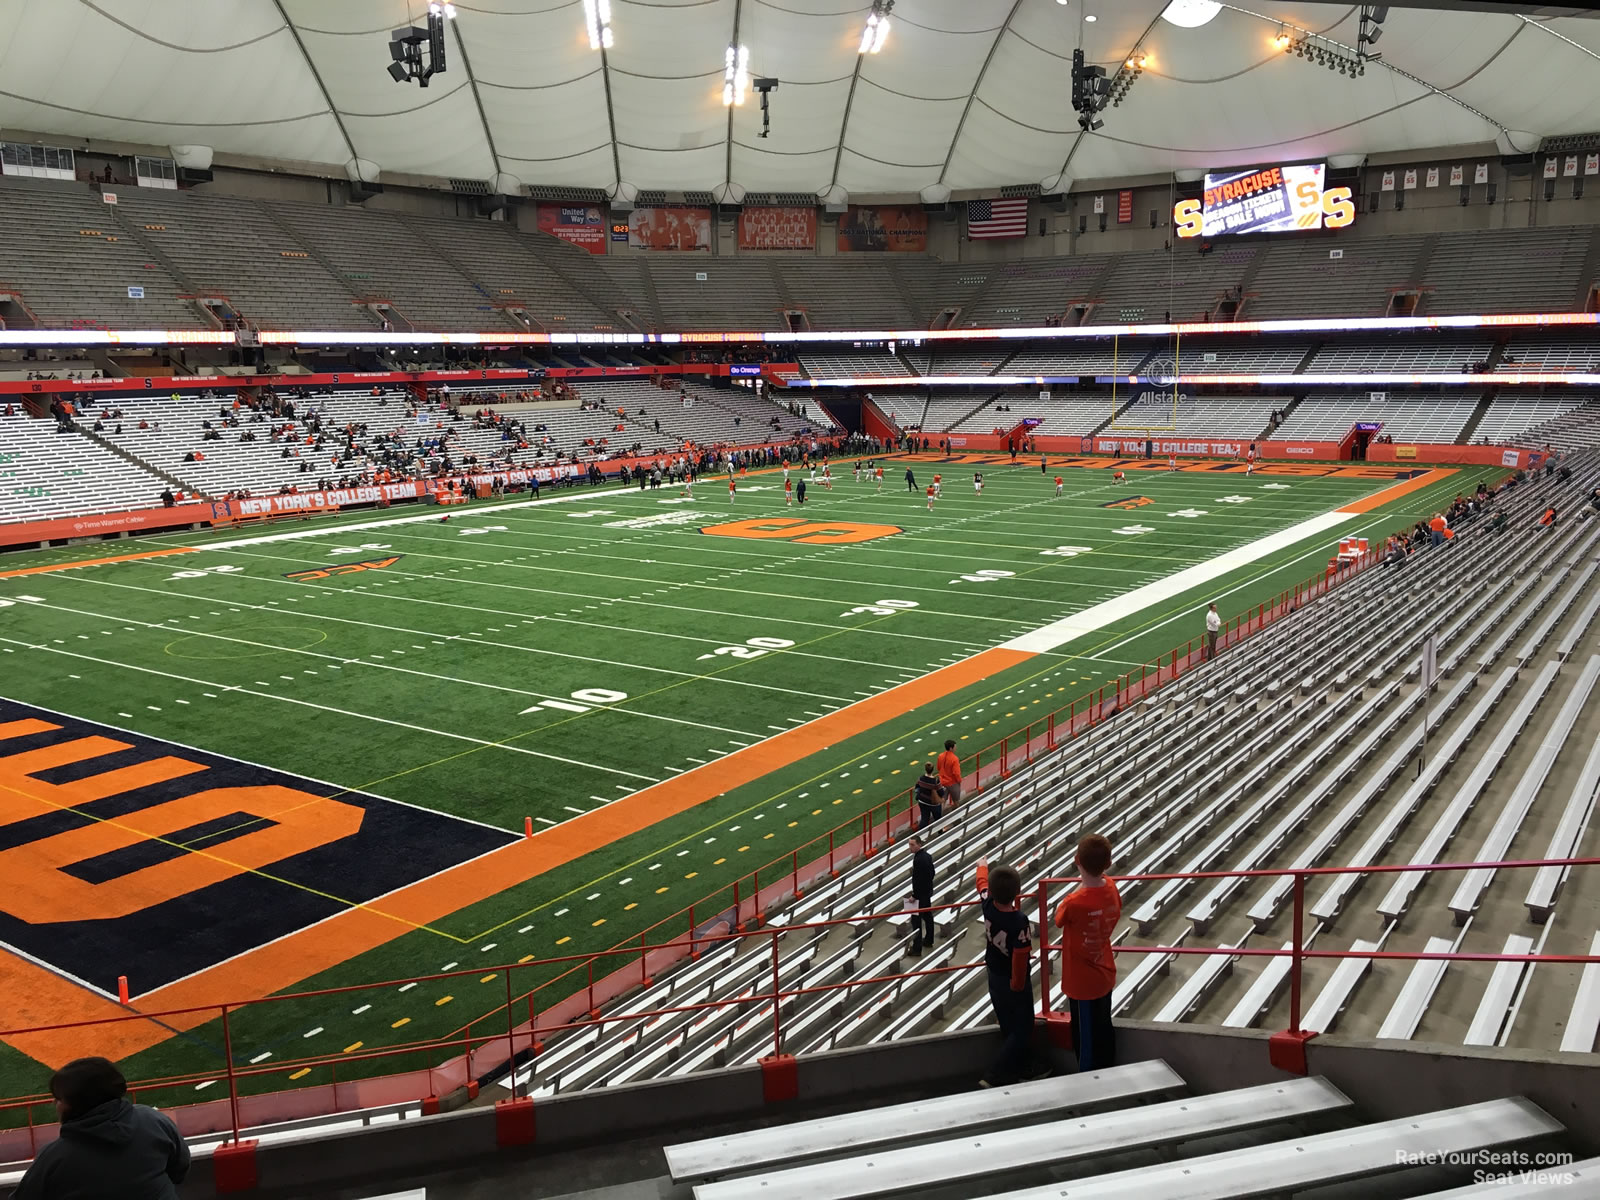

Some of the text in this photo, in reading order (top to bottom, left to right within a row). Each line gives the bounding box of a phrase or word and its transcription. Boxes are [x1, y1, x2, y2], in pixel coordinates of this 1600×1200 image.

[1204, 167, 1282, 206] SYRACUSE
[1323, 187, 1355, 228] S
[571, 216, 584, 224] Way
[1174, 199, 1203, 238] S
[1227, 208, 1255, 230] SALE
[682, 333, 763, 342] SYRACUSE FOOTBALL
[742, 366, 760, 374] Orange
[144, 378, 152, 389] S
[333, 374, 339, 383] S
[1137, 391, 1187, 404] Allstate
[1082, 438, 1092, 452] S
[1162, 442, 1208, 453] COLLEGE
[1211, 443, 1240, 454] TEAM
[553, 464, 578, 478] TEAM
[240, 483, 416, 514] NEW YORK'S COLLEGE TEAM
[214, 502, 228, 518] S
[698, 518, 905, 544] S
[1039, 546, 1093, 556] 50
[960, 570, 1016, 582] 40
[854, 599, 920, 616] 30
[714, 636, 796, 659] 20
[538, 688, 628, 712] 10
